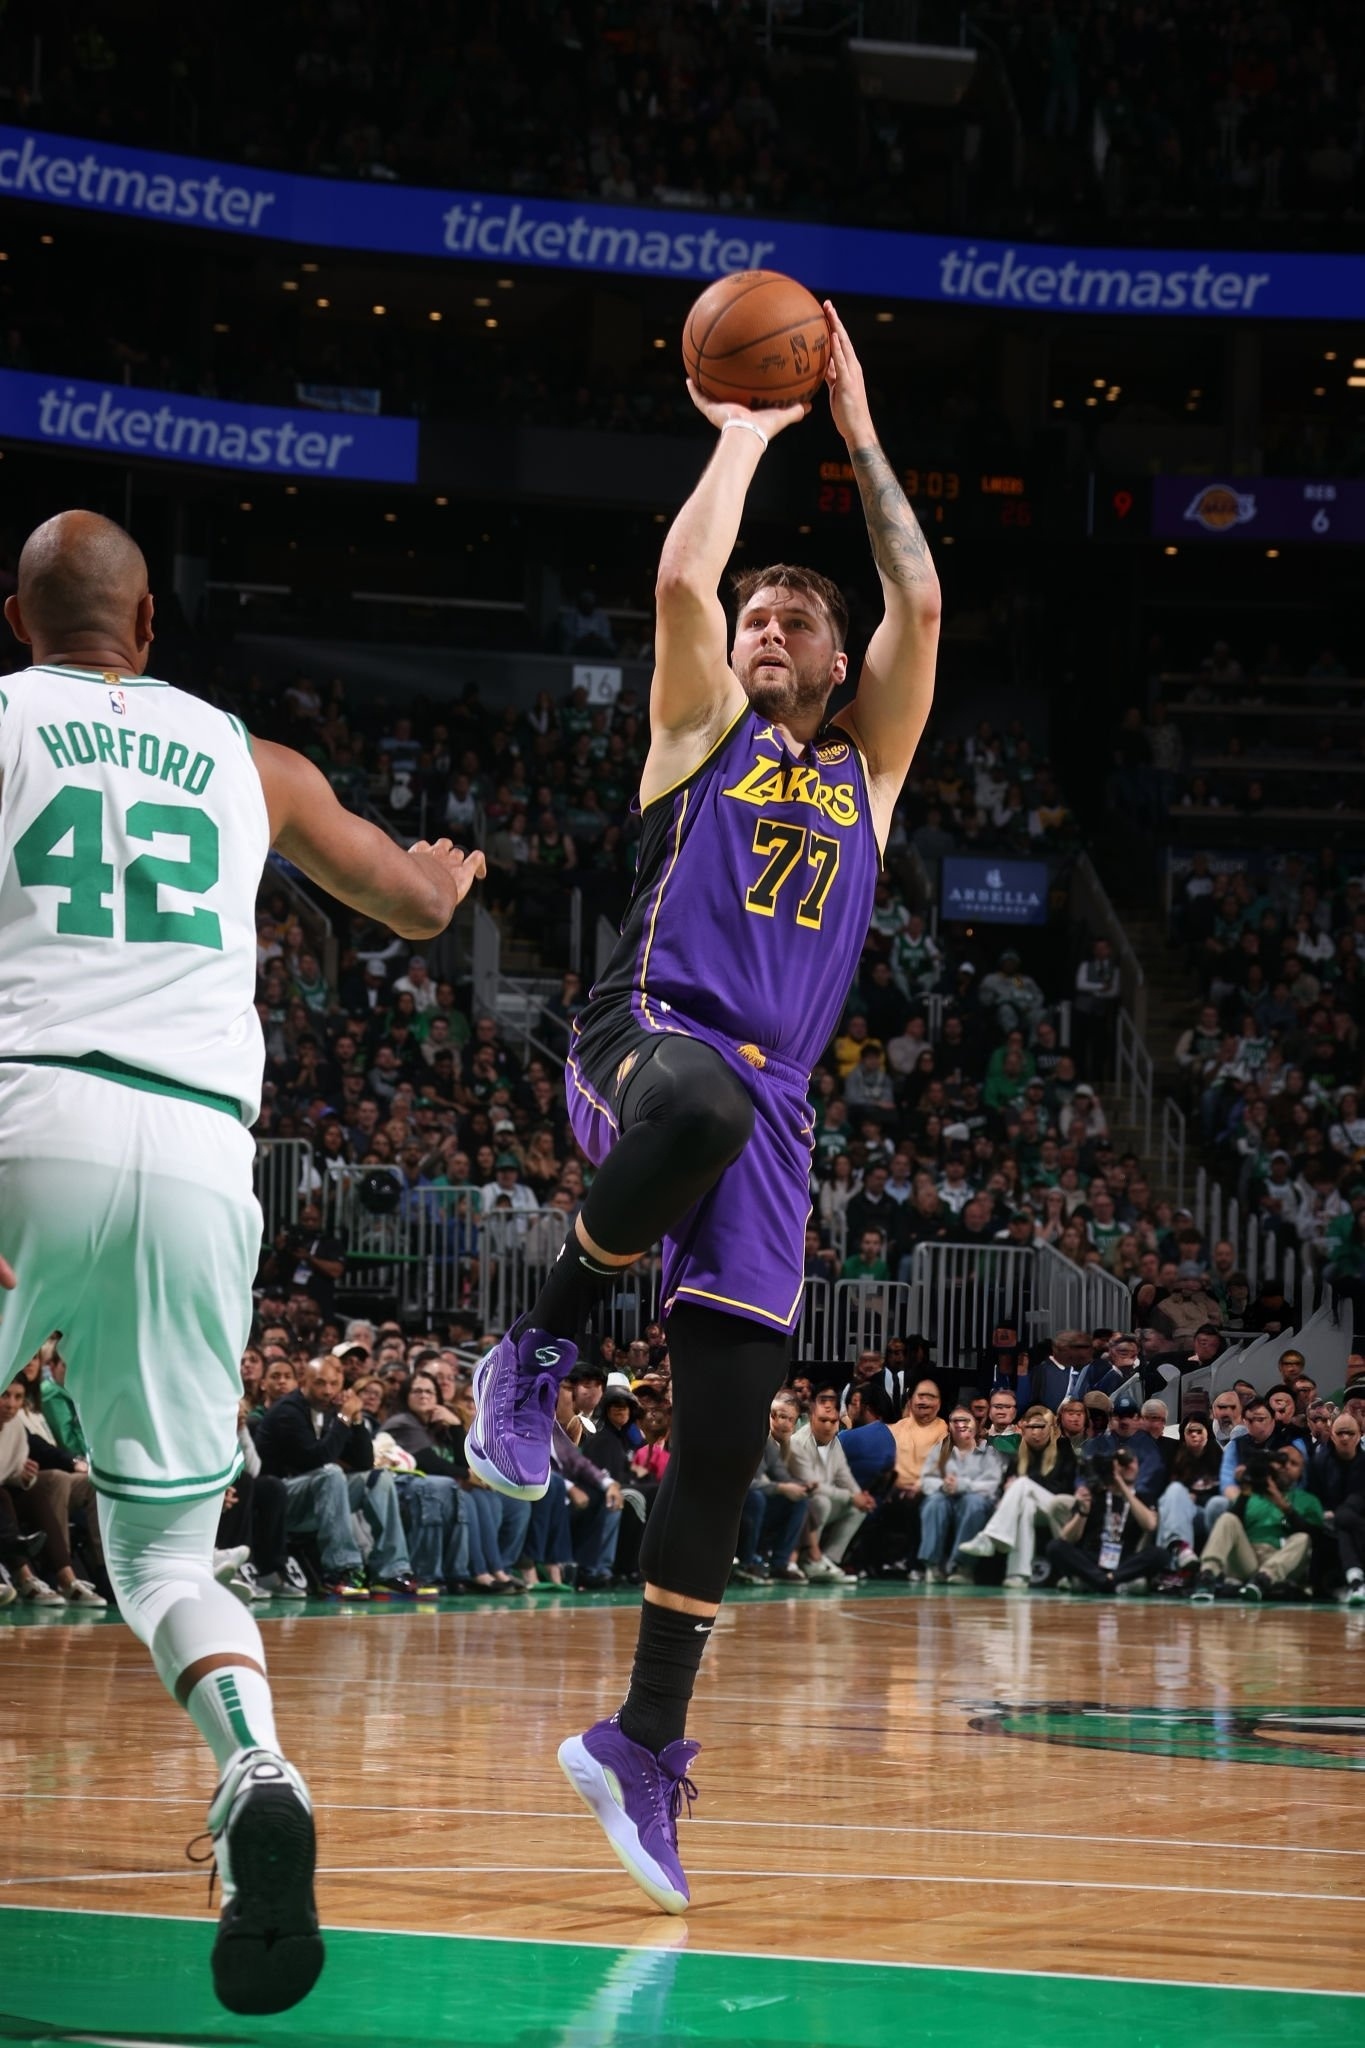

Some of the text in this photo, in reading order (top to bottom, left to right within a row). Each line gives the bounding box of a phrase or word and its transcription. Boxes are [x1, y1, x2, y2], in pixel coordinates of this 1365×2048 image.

[441, 201, 776, 274] ticketmaster
[938, 247, 1270, 309] ticketmaster
[37, 386, 354, 470] ticketmaster
[1311, 507, 1330, 534] 6
[37, 721, 216, 796] HORFORD
[13, 785, 224, 951] 42
[745, 818, 840, 930] 77
